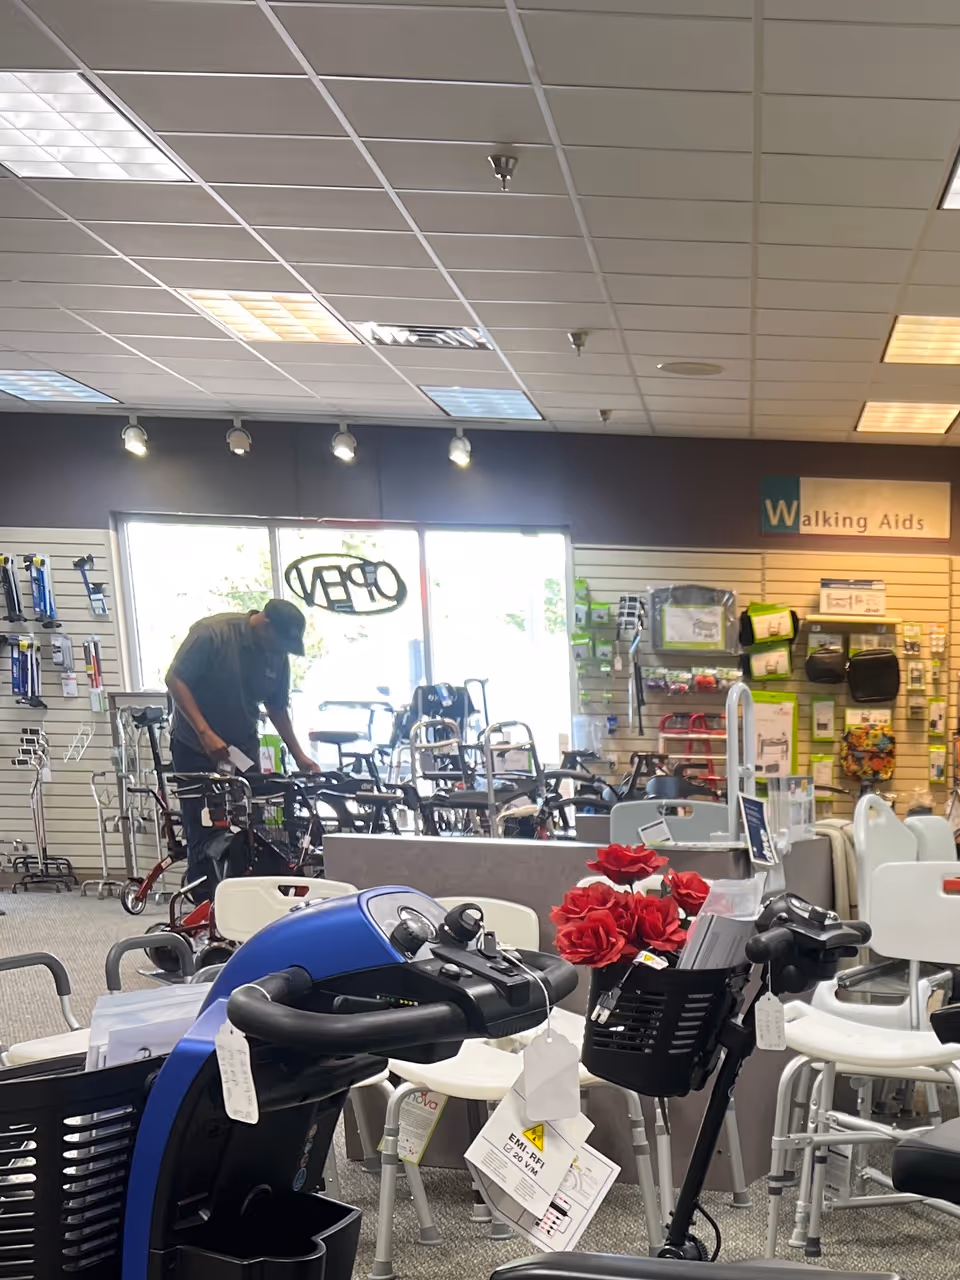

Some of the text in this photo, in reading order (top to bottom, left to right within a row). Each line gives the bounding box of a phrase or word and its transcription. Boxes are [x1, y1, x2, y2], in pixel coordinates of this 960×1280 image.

[764, 498, 925, 533] Walking Aids
[407, 1090, 438, 1110] nova
[508, 1133, 545, 1169] EMI-RFI
[512, 1151, 538, 1177] 20 V/M
